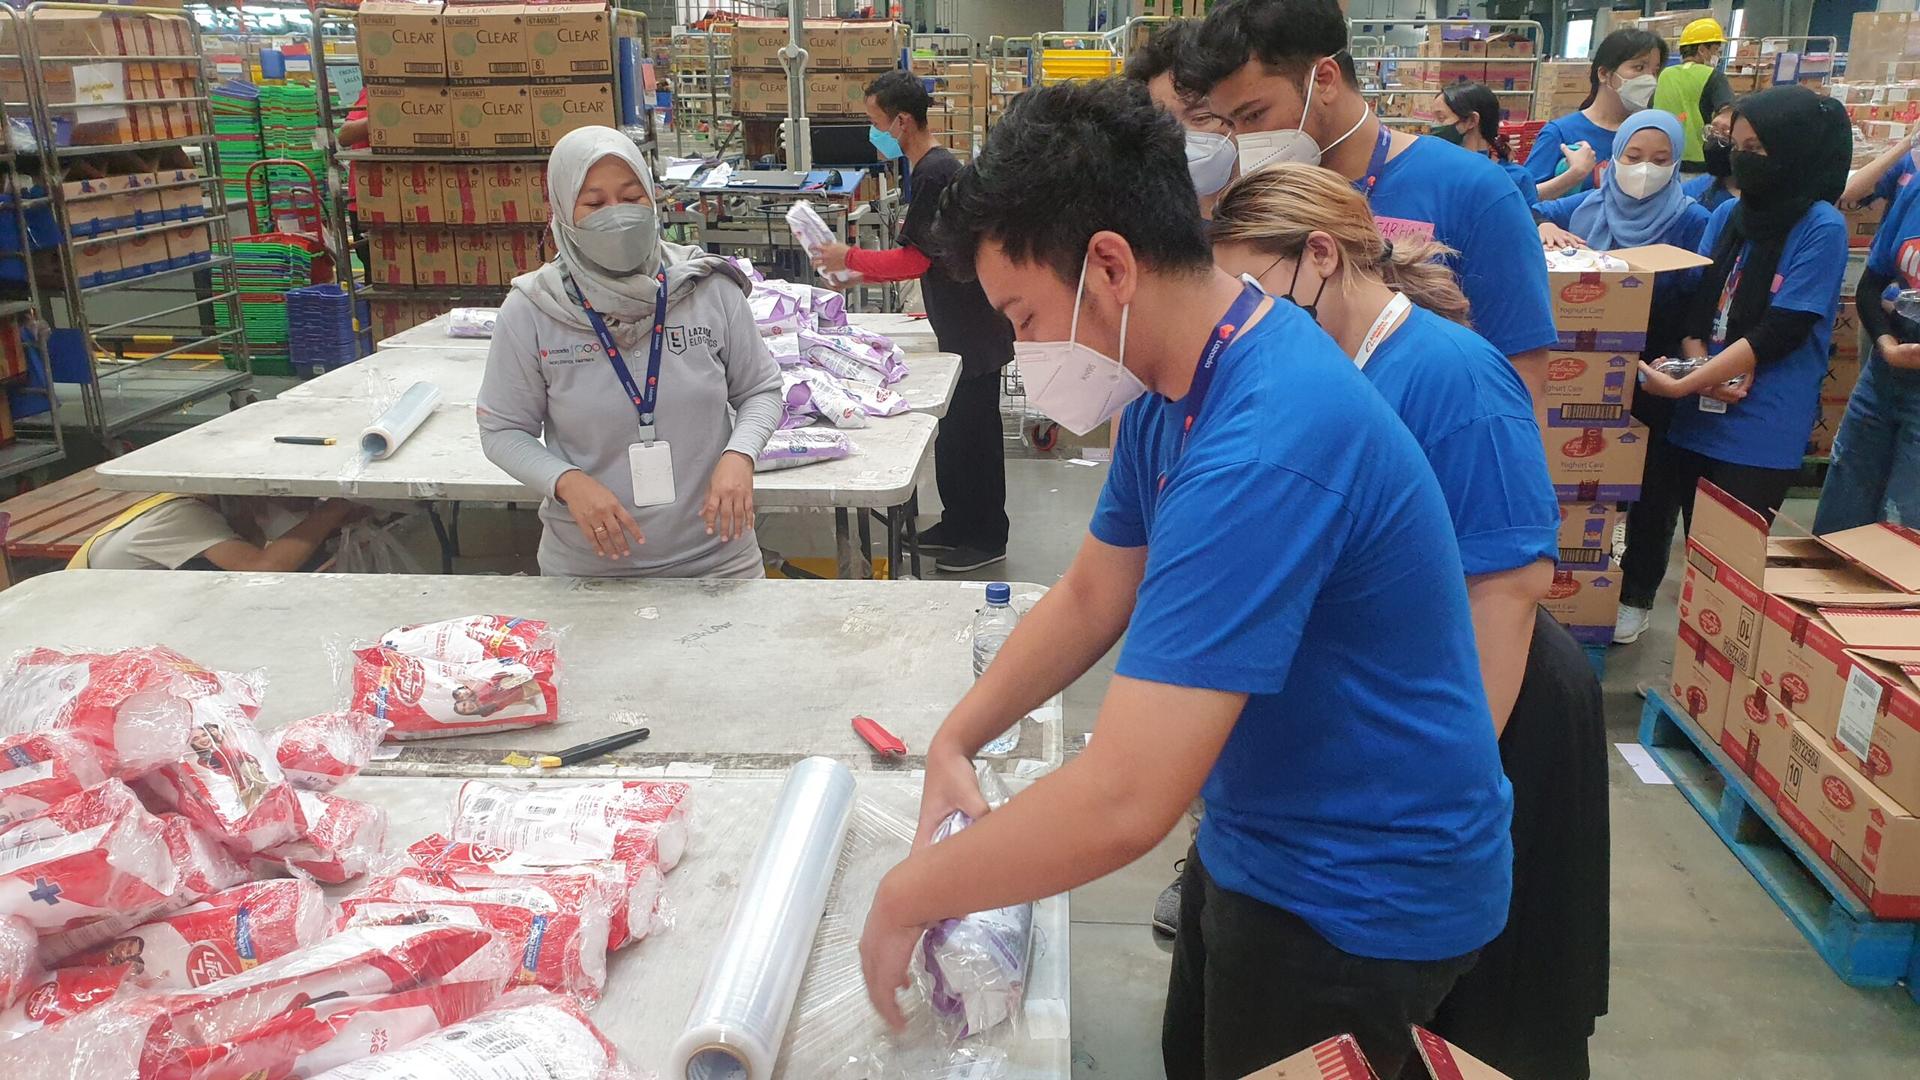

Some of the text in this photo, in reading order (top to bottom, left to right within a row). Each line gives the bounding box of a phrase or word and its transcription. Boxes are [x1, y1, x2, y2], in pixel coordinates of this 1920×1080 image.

[392, 29, 434, 44] CLEAR
[476, 29, 519, 44] CLEAR
[557, 28, 599, 43] CLEAR
[758, 36, 785, 47] CLEAR
[810, 37, 836, 48] CLEAR
[861, 36, 888, 47] CLEAR
[401, 101, 444, 115] CLEAR
[482, 101, 523, 116] CLEAR
[562, 99, 605, 114] CLEAR
[1204, 339, 1223, 369] Lazada
[1739, 620, 1751, 641] 10
[1788, 762, 1801, 785] 10
